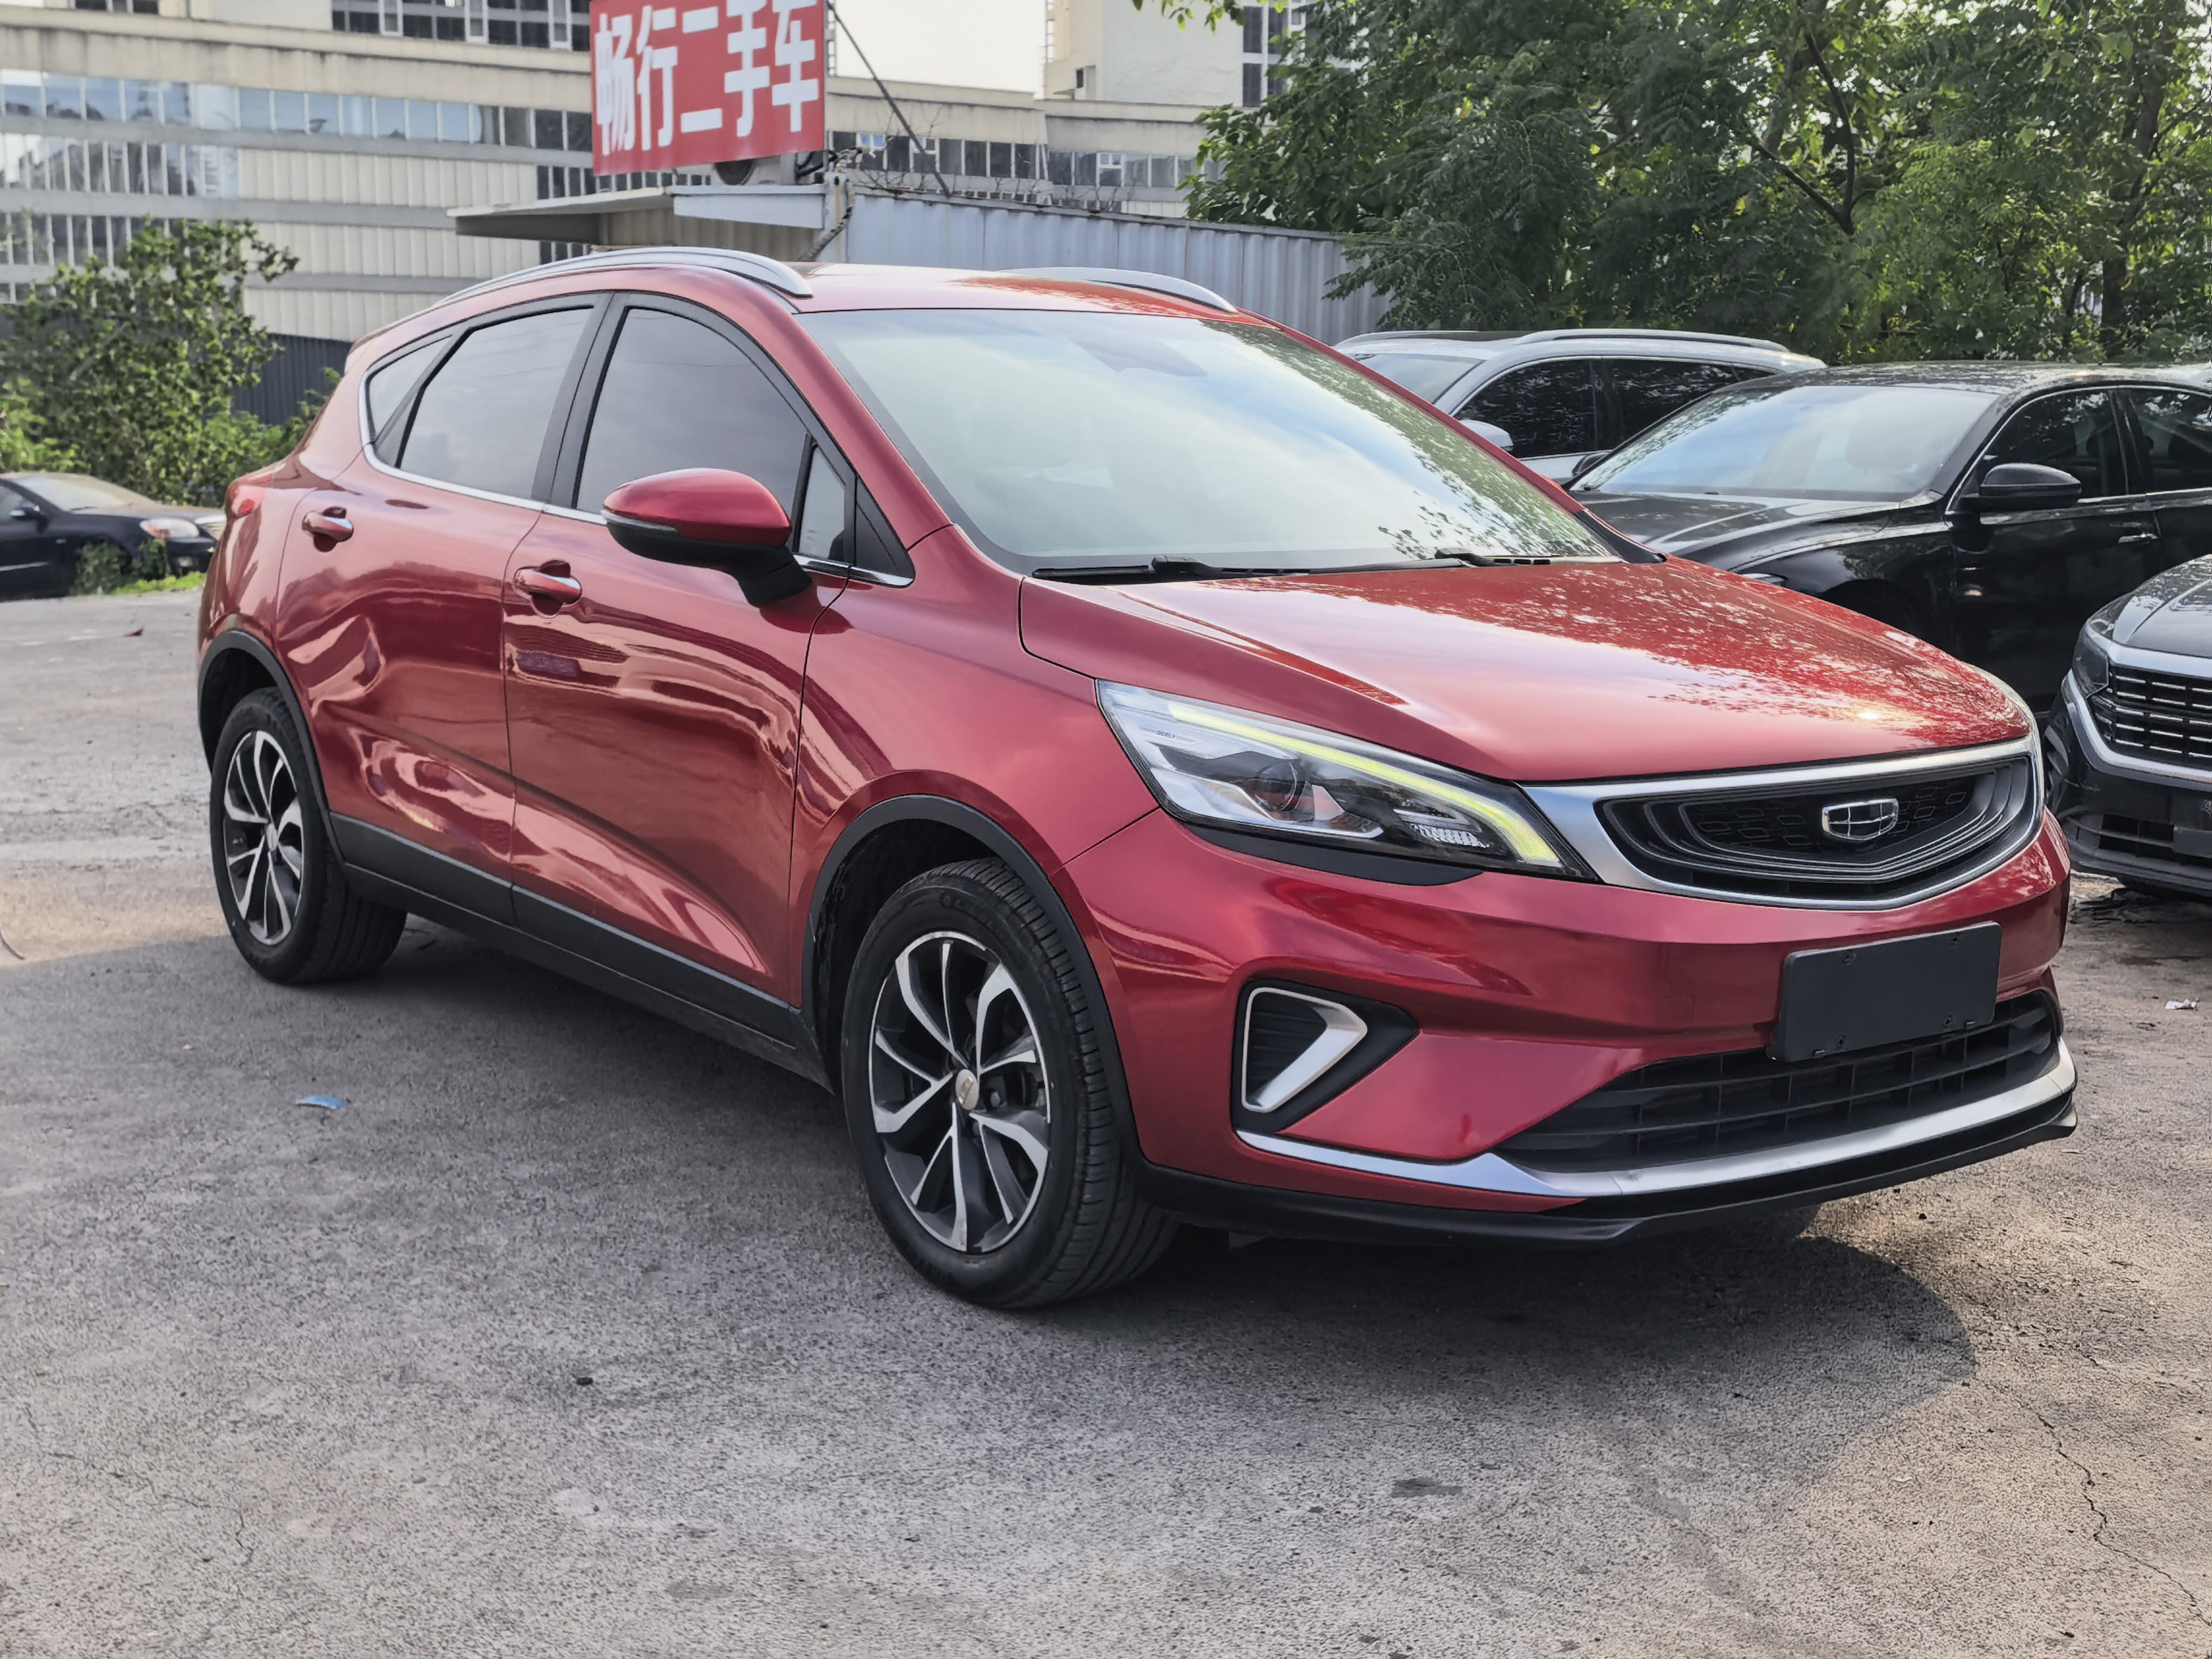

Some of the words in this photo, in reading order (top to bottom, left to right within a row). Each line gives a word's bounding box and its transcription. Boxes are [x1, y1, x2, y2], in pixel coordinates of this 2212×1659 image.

[595, 0, 819, 156] 畅行二手车
